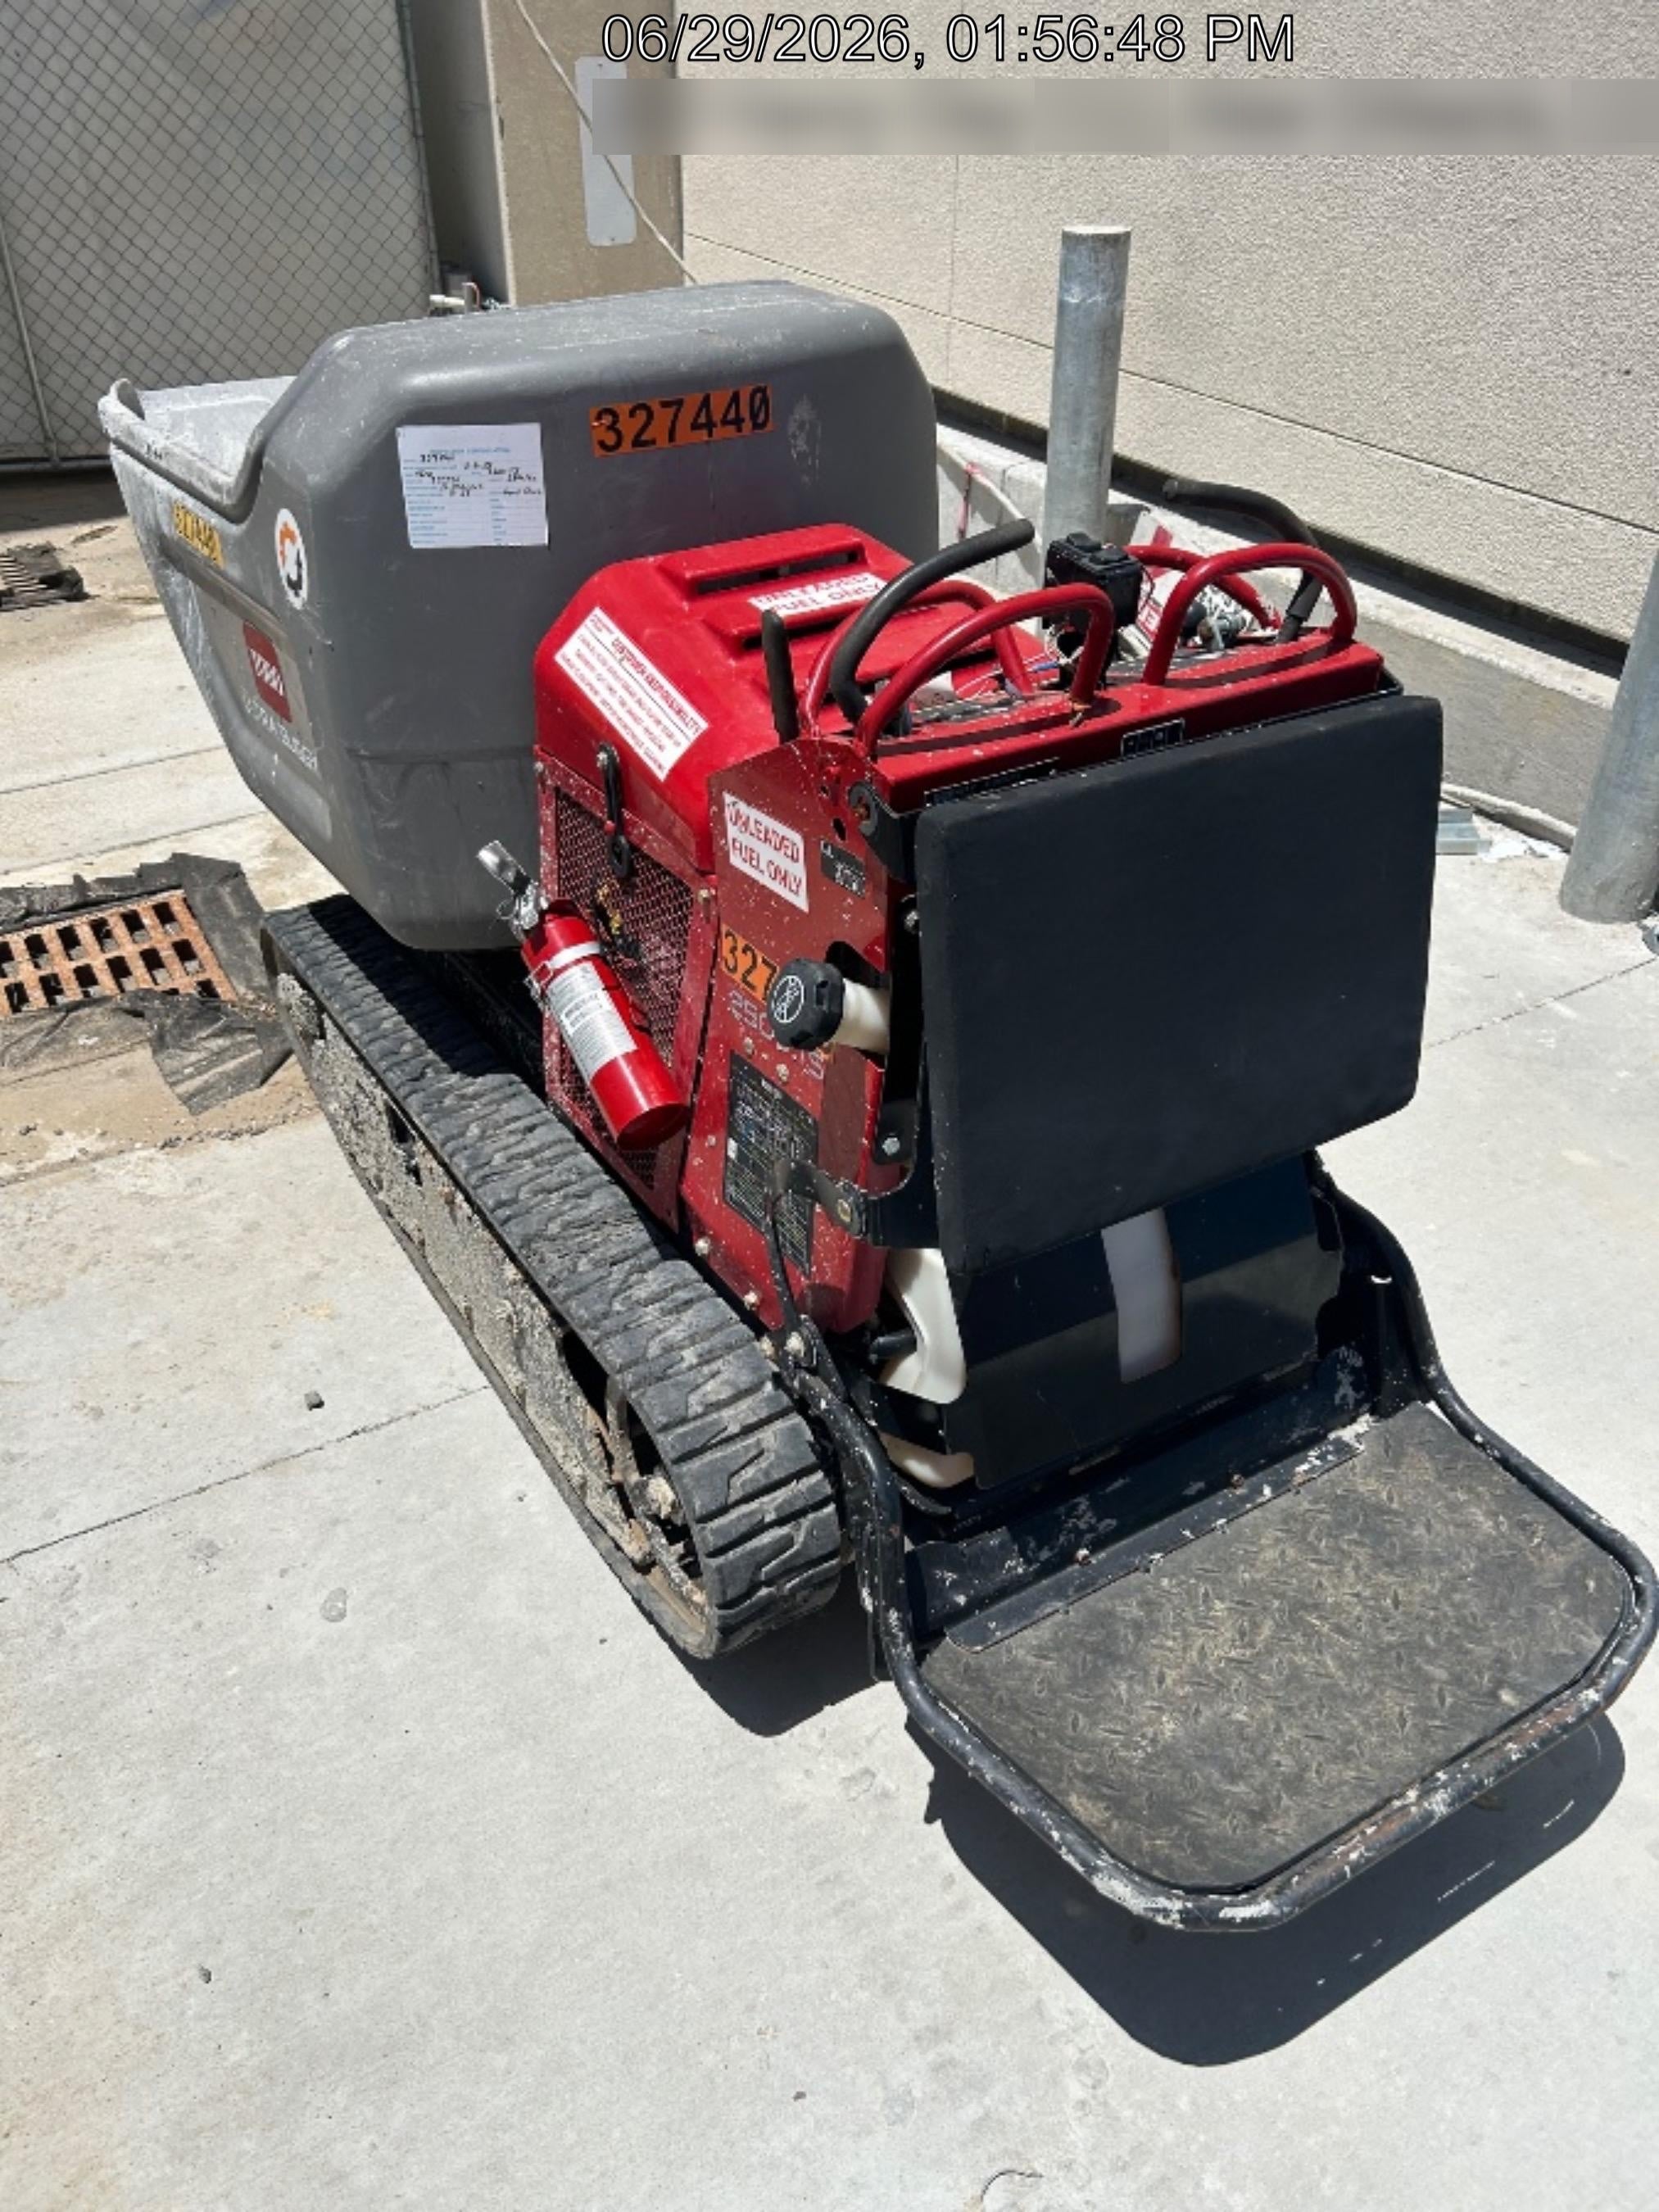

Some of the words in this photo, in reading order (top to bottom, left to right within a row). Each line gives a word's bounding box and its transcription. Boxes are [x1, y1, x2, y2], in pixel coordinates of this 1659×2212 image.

[596, 385, 771, 453] 327440
[728, 804, 800, 863] UNLEADED
[732, 837, 765, 875] FUEL
[766, 859, 802, 897] ONLY
